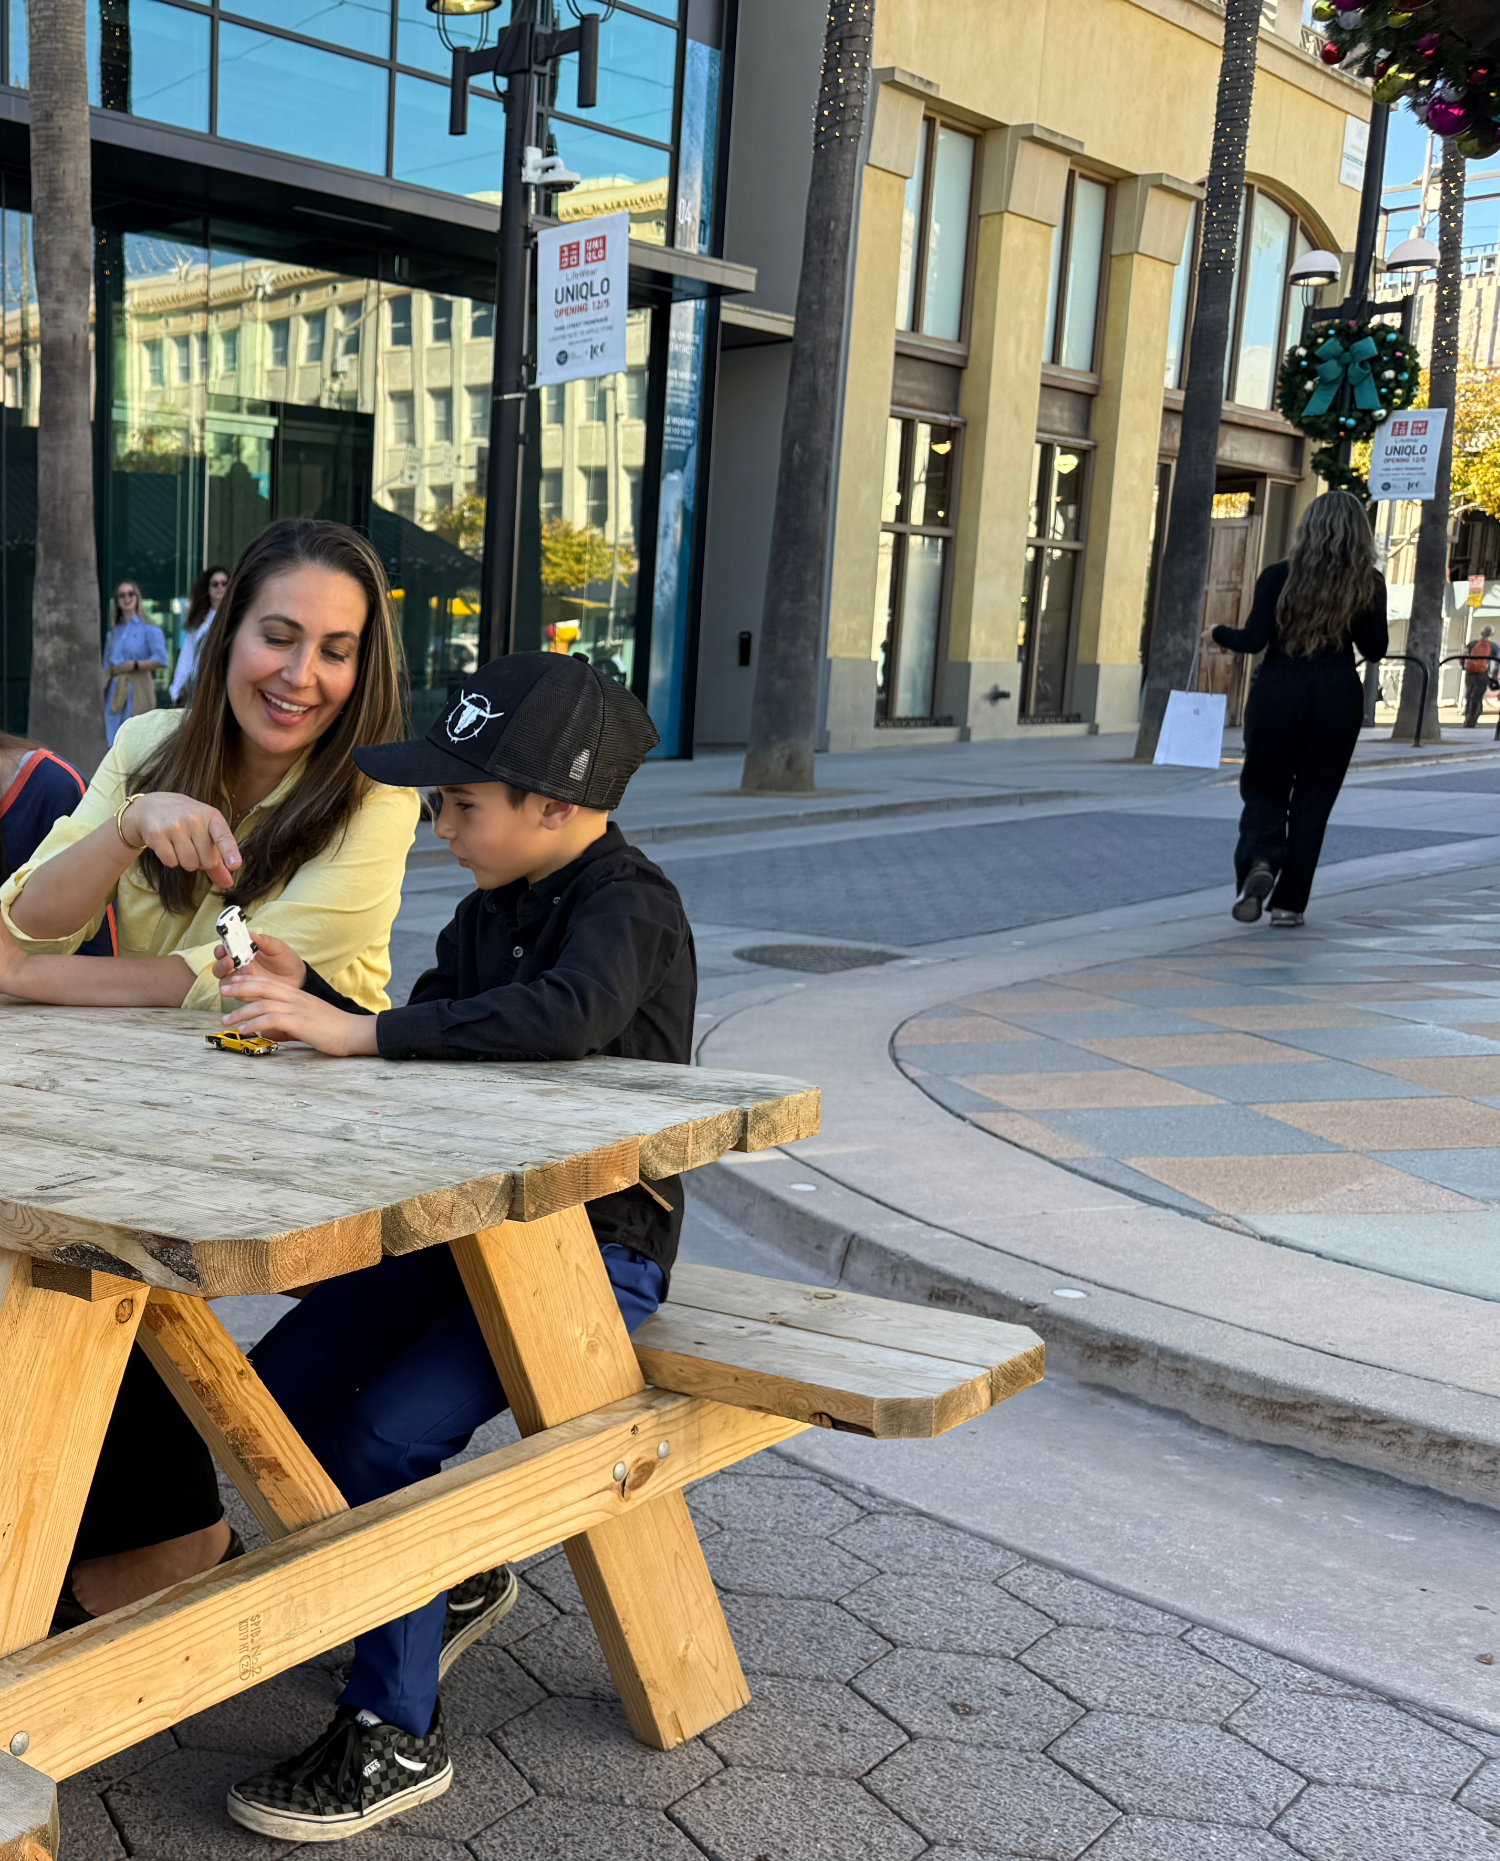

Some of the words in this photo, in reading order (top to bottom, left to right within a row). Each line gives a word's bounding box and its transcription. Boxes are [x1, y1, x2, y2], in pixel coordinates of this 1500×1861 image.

[554, 277, 610, 305] UNIQLO
[554, 303, 589, 318] OPENING
[592, 298, 610, 310] 12/5
[1384, 444, 1428, 457] UNIQLO
[362, 1758, 381, 1778] VANS
